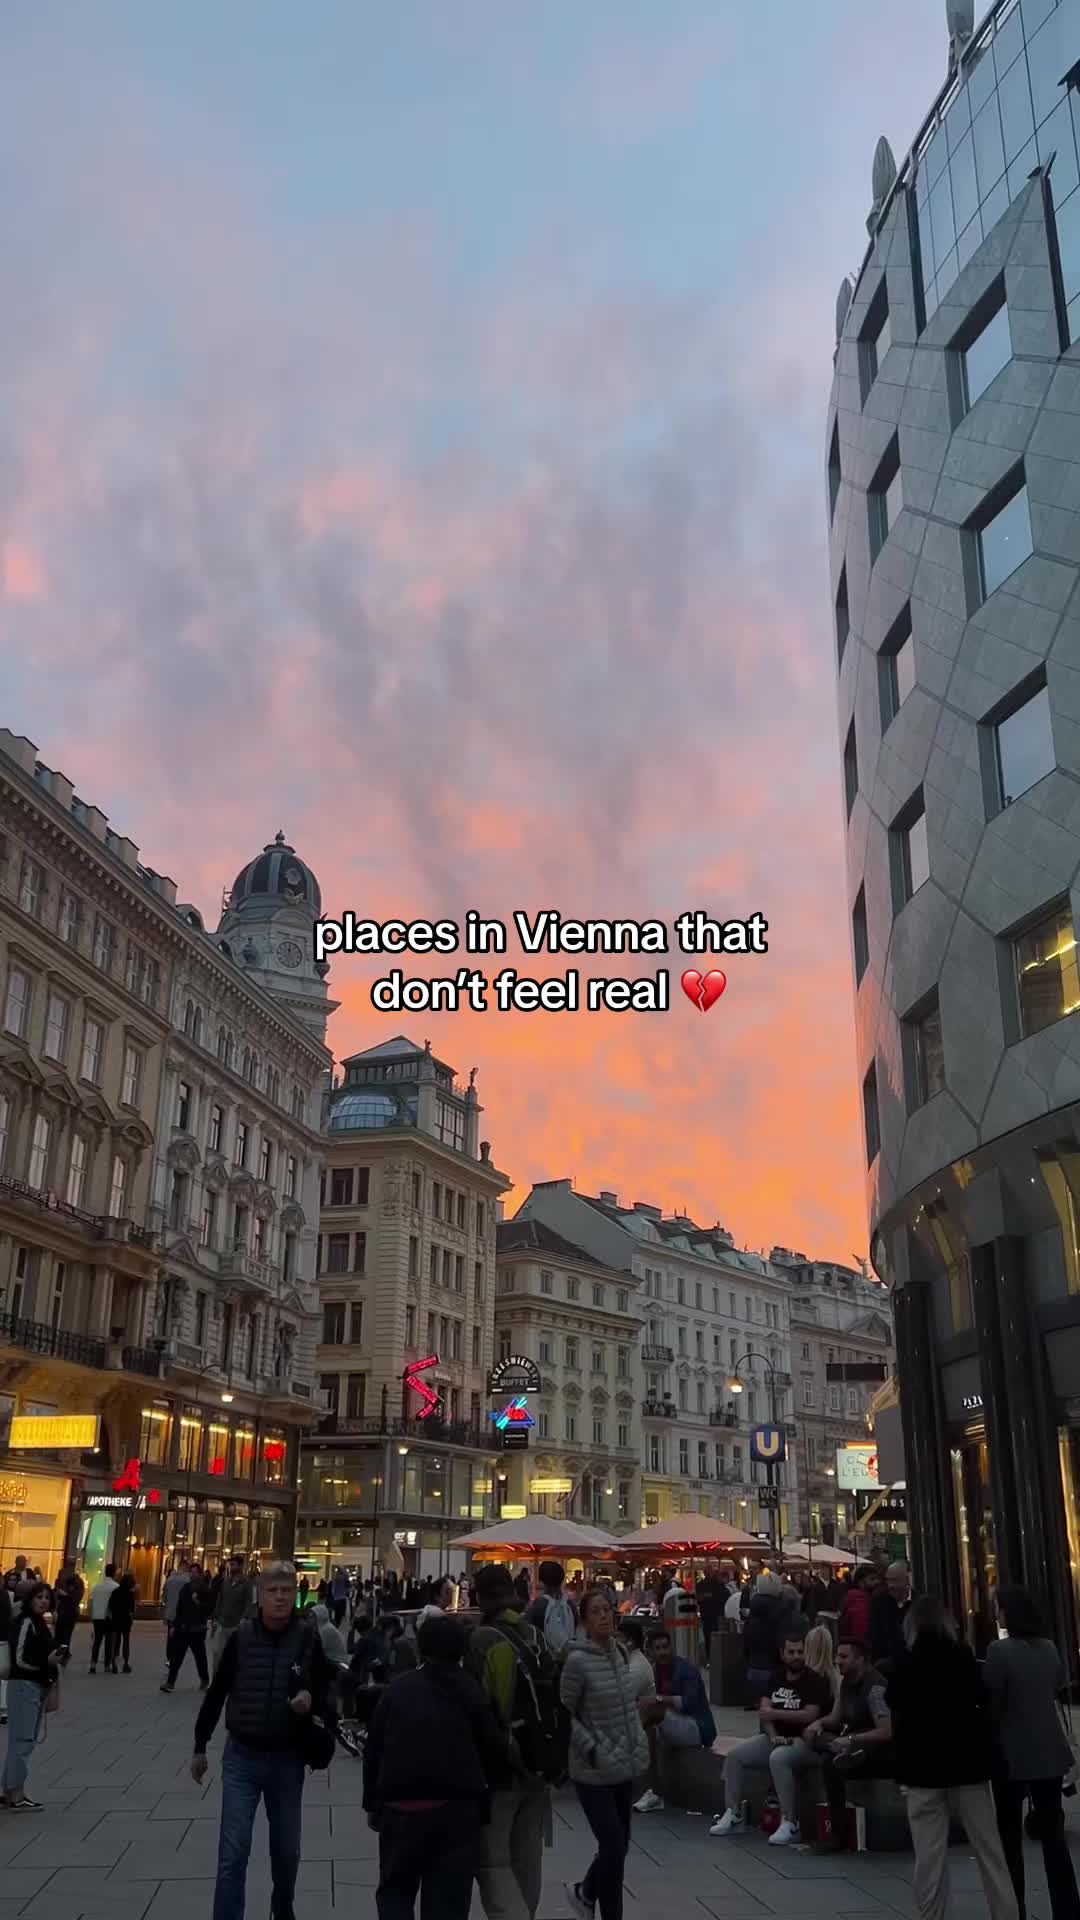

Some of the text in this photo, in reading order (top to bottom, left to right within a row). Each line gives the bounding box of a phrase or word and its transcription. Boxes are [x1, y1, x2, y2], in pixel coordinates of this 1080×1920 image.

[500, 1378, 530, 1387] BUFFET
[755, 1431, 780, 1457] U
[759, 1487, 777, 1500] WC
